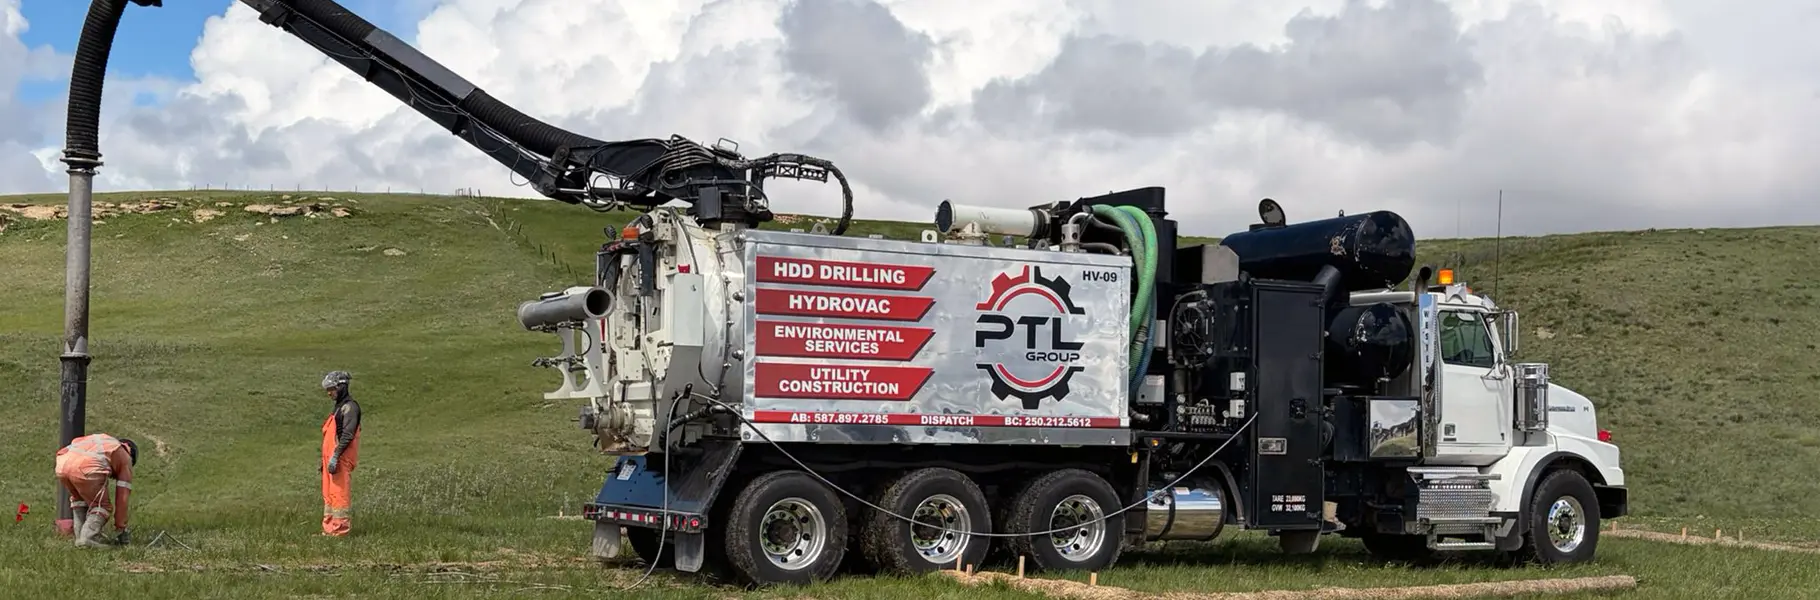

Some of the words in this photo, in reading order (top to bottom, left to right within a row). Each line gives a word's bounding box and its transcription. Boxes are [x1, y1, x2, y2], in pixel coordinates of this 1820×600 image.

[774, 262, 814, 279] HDD
[819, 265, 906, 284] DRILLING
[1082, 270, 1118, 283] HV-09
[789, 294, 891, 314] HYDROVAC
[774, 325, 904, 343] ENVIRONMENTAL
[975, 314, 1085, 351] PTL
[805, 339, 879, 354] SERVICES
[1025, 351, 1080, 363] GROUP
[810, 368, 870, 382] UTILITY
[779, 379, 899, 395] CONSTRUCTION
[791, 413, 811, 423] AB:
[814, 413, 889, 424] 587.897.2785
[921, 416, 974, 426] DISPATCH
[1004, 417, 1023, 427] BC:
[1025, 416, 1091, 427] 250.212.5612
[1272, 495, 1284, 503] TARE
